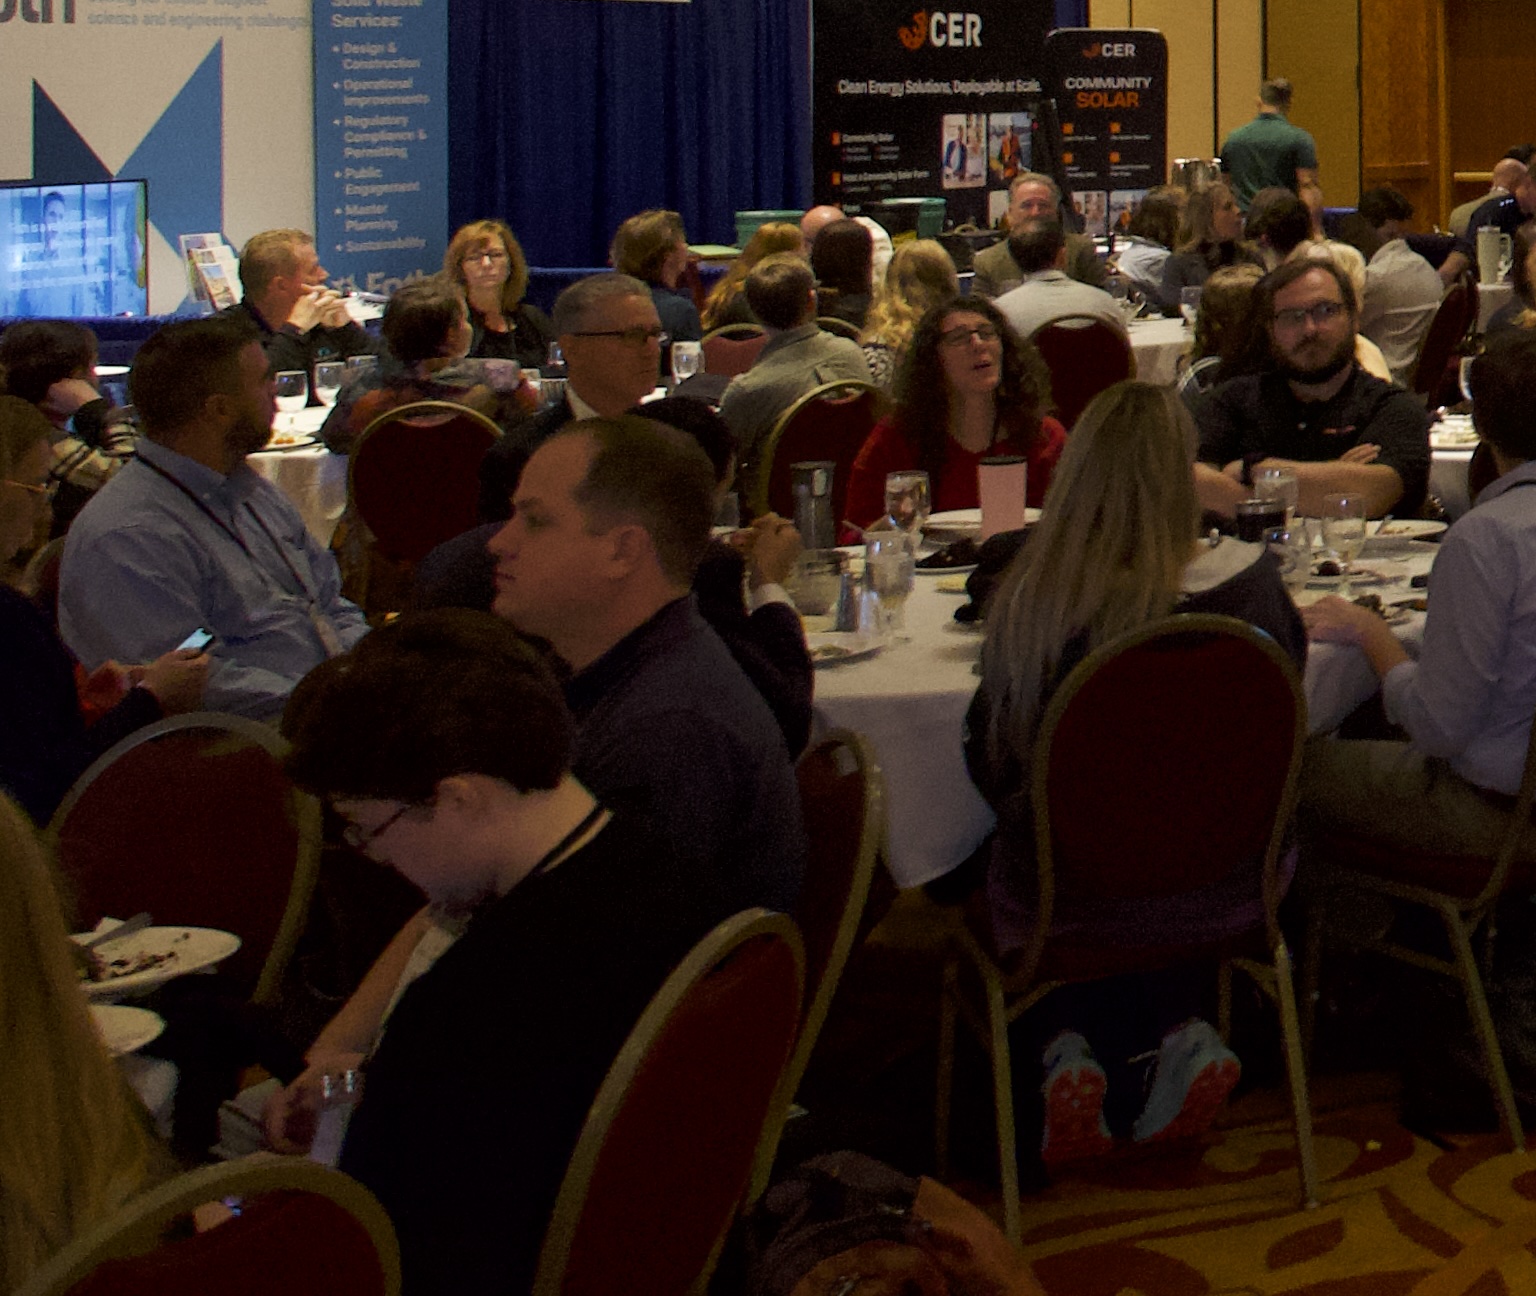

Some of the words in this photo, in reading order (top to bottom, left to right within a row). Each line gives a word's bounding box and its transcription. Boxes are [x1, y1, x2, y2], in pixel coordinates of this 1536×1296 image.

[930, 11, 982, 47] CER
[343, 42, 384, 56] Design
[1101, 43, 1136, 57] CER
[343, 57, 421, 70] Construction
[838, 79, 867, 94] Clean
[868, 80, 904, 97] Energy
[953, 79, 1004, 96] Deployable
[1065, 77, 1152, 90] COMMUNITY
[1076, 91, 1140, 108] SOLAR
